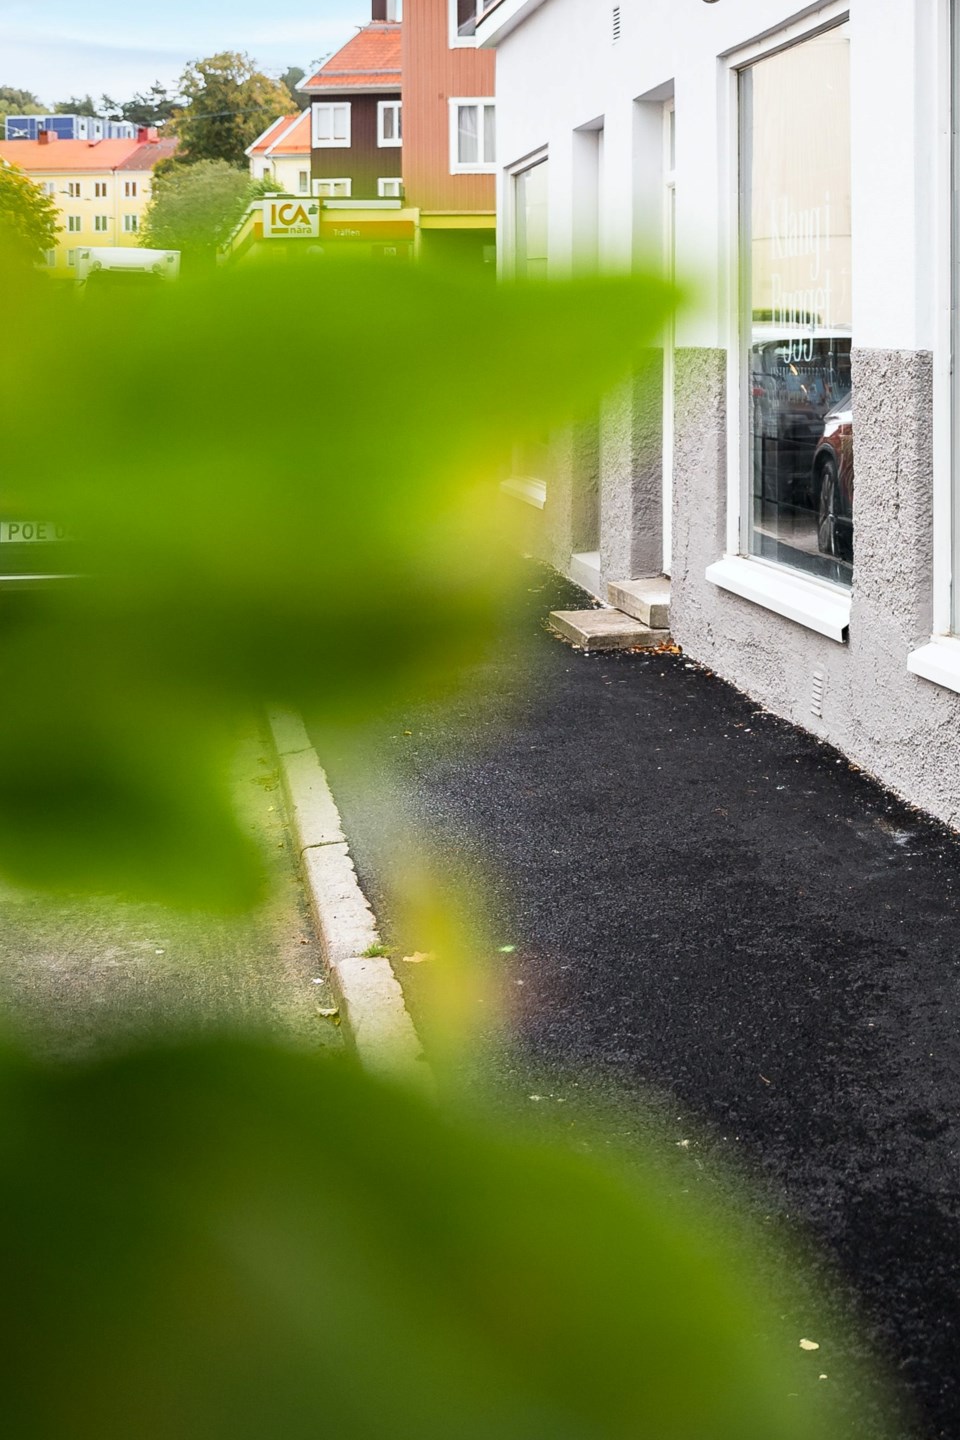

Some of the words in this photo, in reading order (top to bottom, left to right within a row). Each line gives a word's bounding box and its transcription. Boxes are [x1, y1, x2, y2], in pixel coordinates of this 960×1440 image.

[271, 203, 312, 226] ICA
[290, 226, 312, 234] nära
[8, 523, 47, 540] POE
